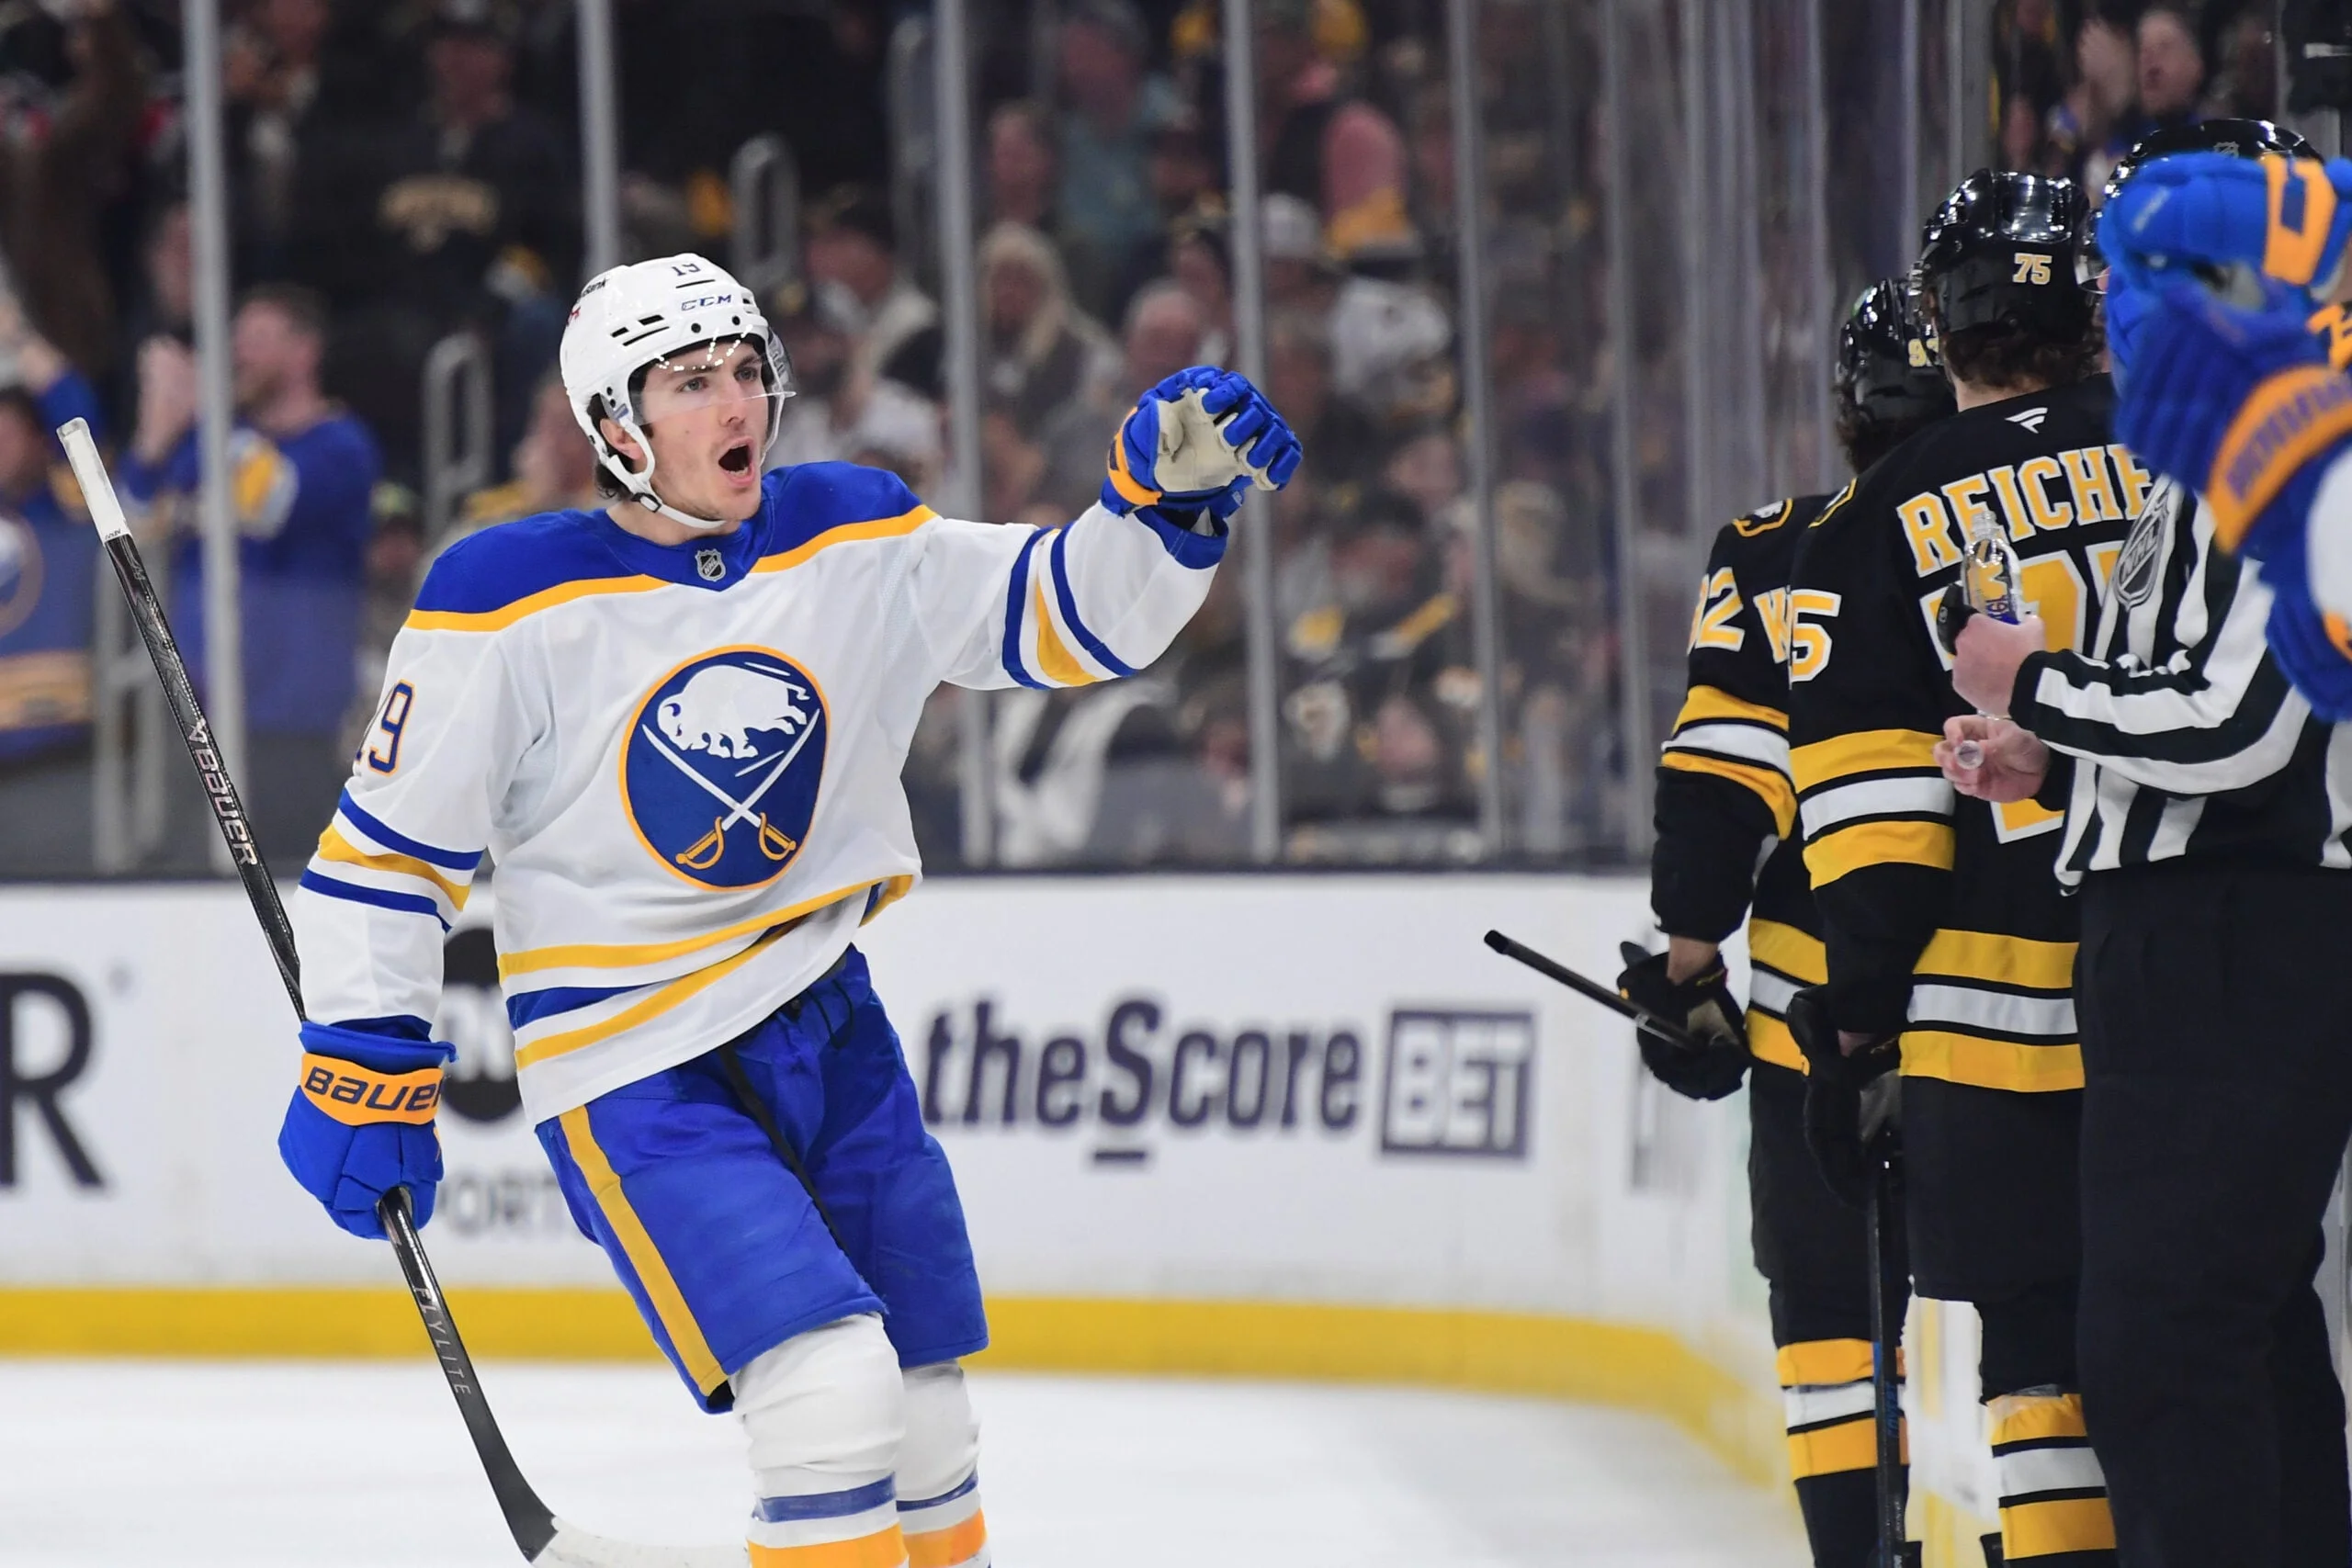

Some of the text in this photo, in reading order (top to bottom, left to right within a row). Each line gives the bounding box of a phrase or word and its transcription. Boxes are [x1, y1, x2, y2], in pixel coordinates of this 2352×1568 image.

[672, 263, 702, 276] 19
[2012, 253, 2052, 285] 75
[681, 294, 731, 311] CCM
[356, 679, 415, 778] 9
[923, 999, 1529, 1149] theScore BET
[413, 1287, 471, 1395] FLYLITE
